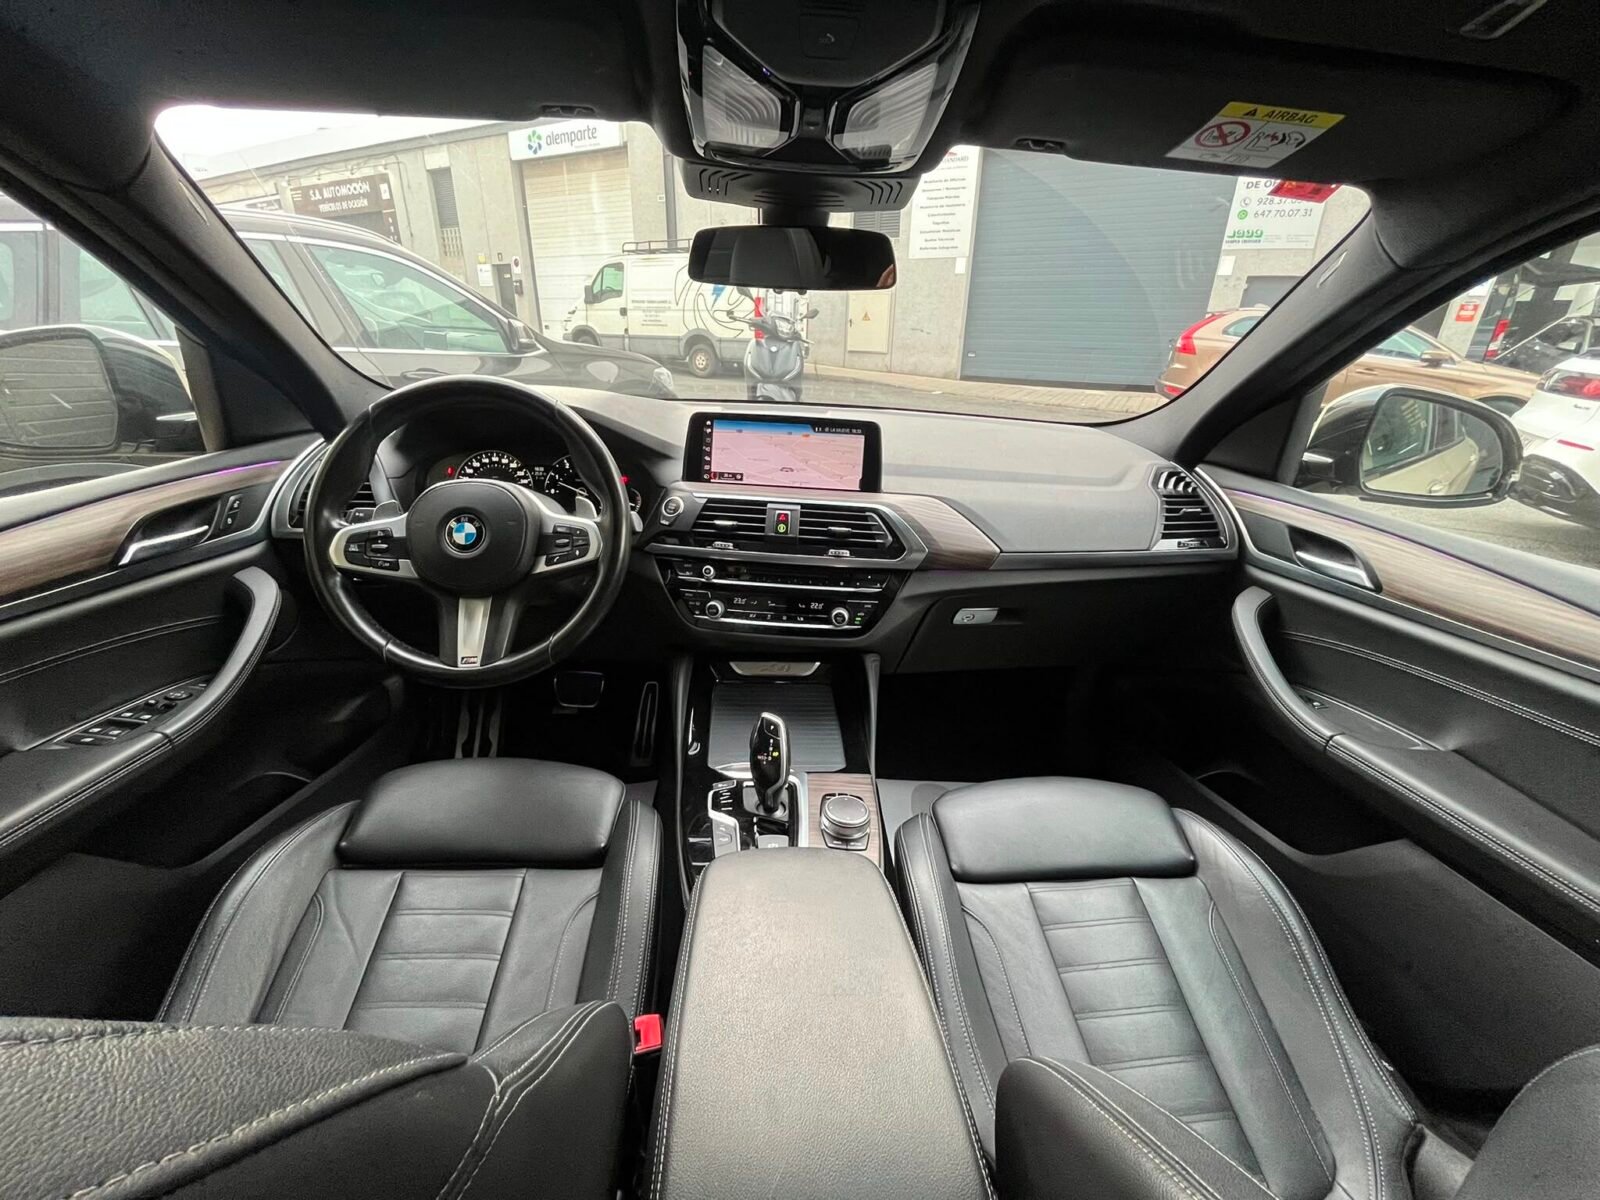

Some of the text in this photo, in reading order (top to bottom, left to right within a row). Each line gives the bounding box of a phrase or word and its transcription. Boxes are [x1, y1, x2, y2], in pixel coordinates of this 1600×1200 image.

[1264, 110, 1318, 124] AIRBAG
[545, 125, 598, 147] alemparte
[309, 188, 322, 201] S.A.
[323, 180, 371, 199] AUTOMOCIÓN
[1246, 180, 1261, 189] DE
[348, 197, 369, 209] OCASIÓN
[1253, 208, 1313, 219] 647.70.07.31
